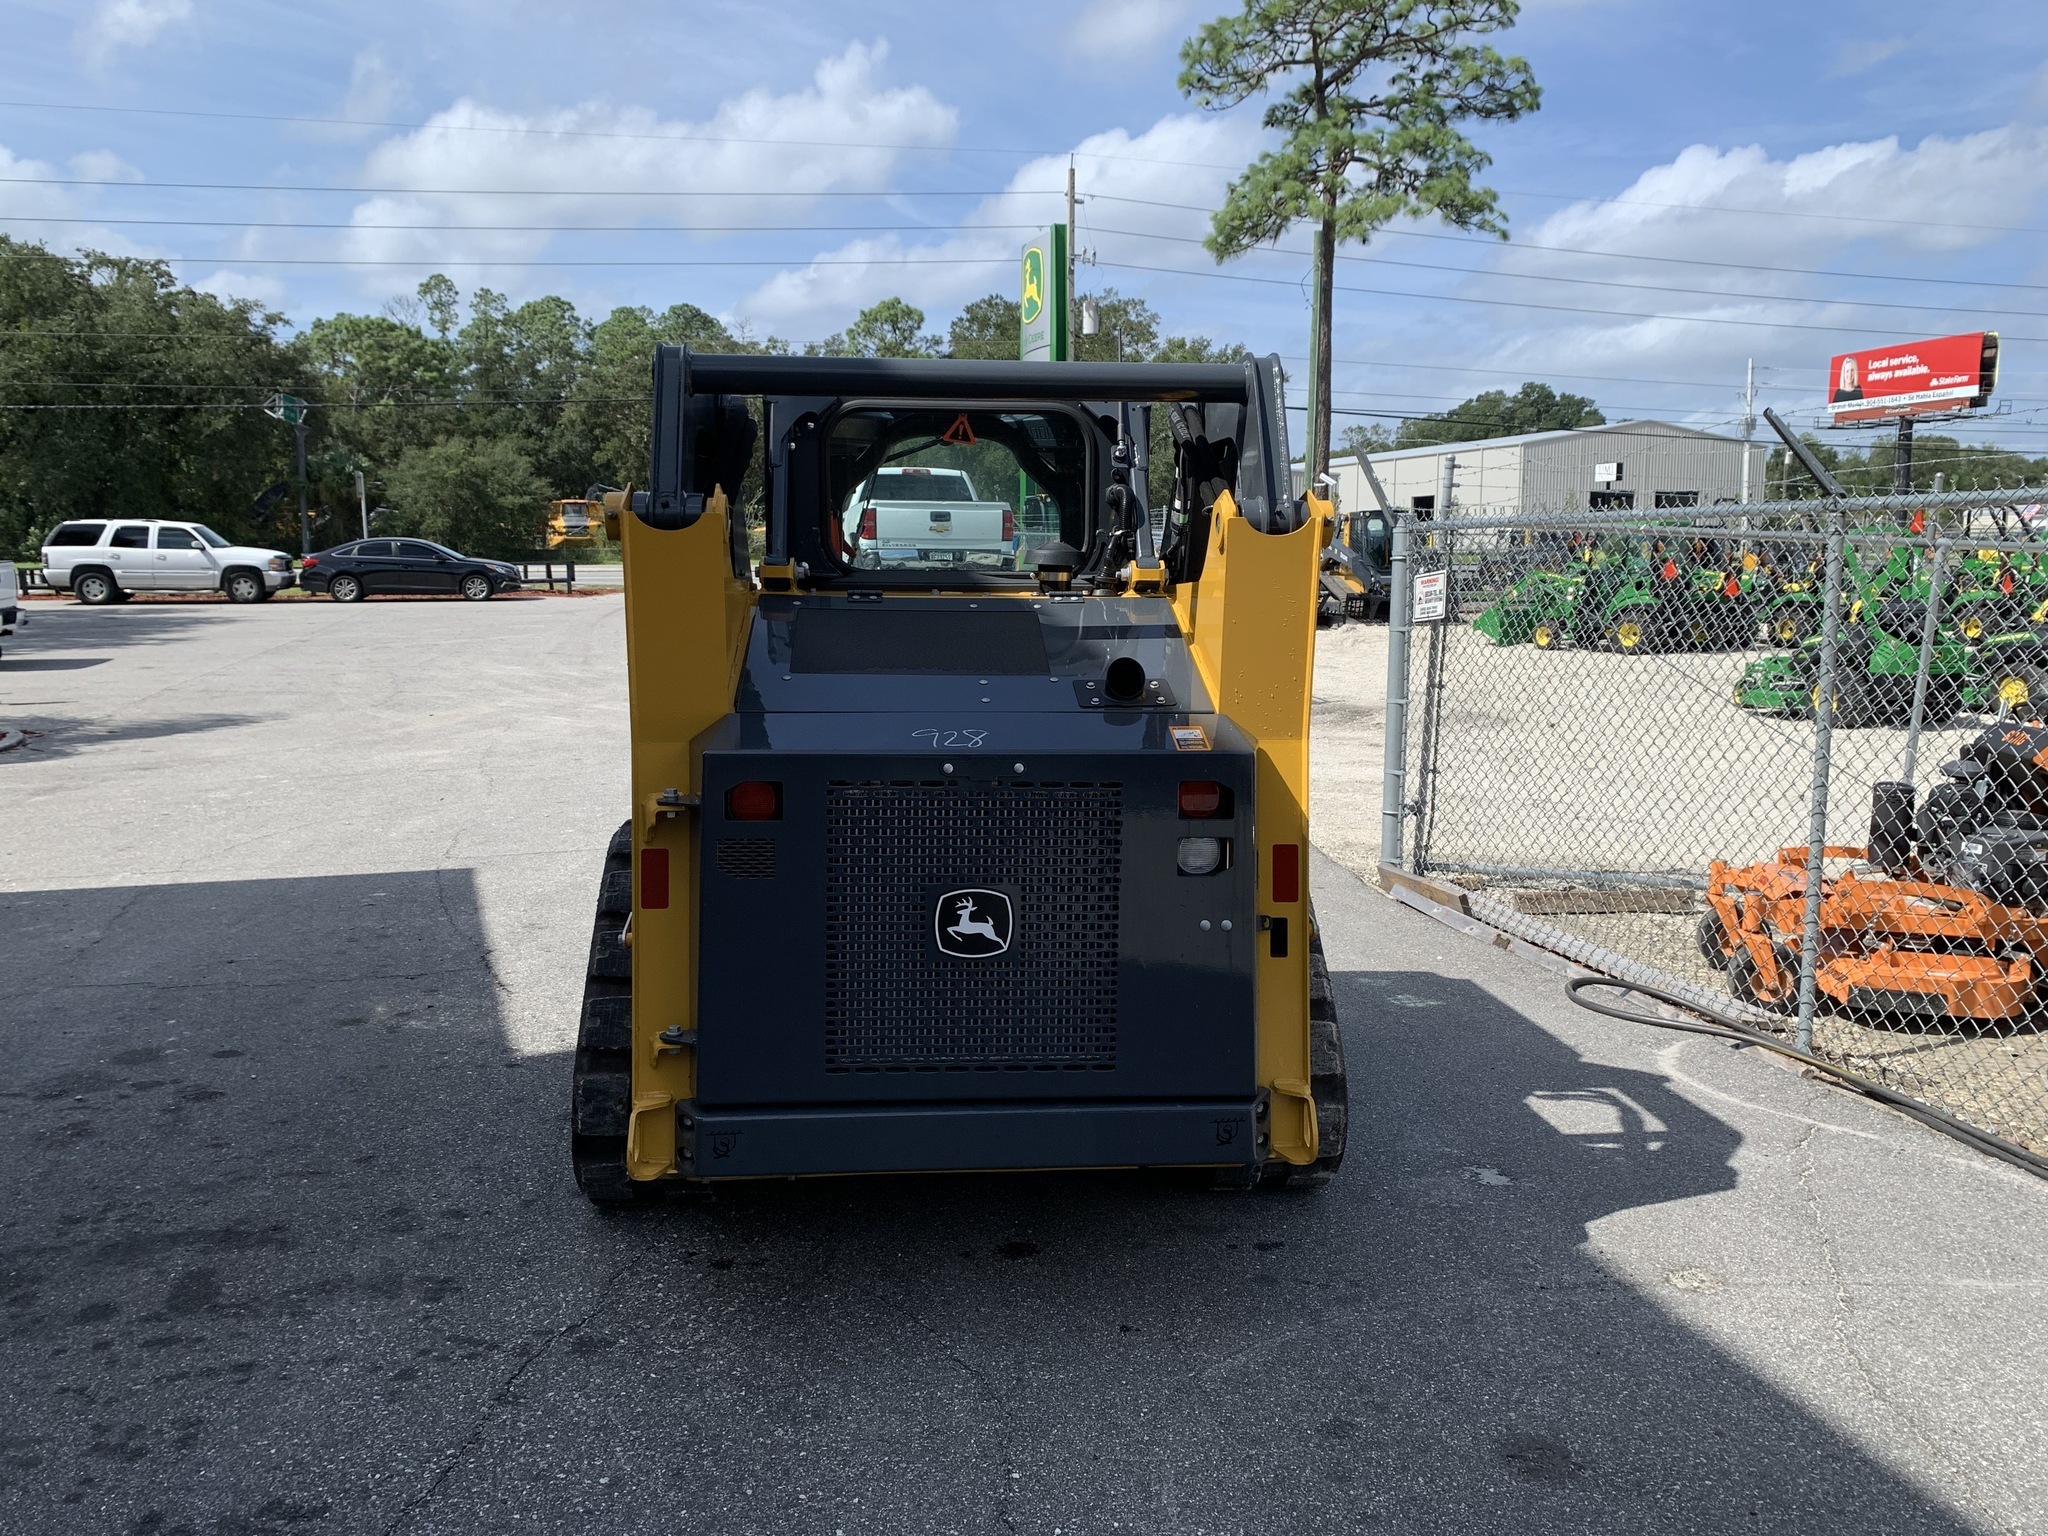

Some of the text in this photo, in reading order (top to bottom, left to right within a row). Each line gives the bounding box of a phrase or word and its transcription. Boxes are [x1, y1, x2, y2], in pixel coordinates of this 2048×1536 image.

[1868, 354, 1919, 370] Local service,
[1867, 365, 1930, 382] always available.
[1866, 396, 1902, 407] 904-551-1643
[911, 729, 990, 748] 928
